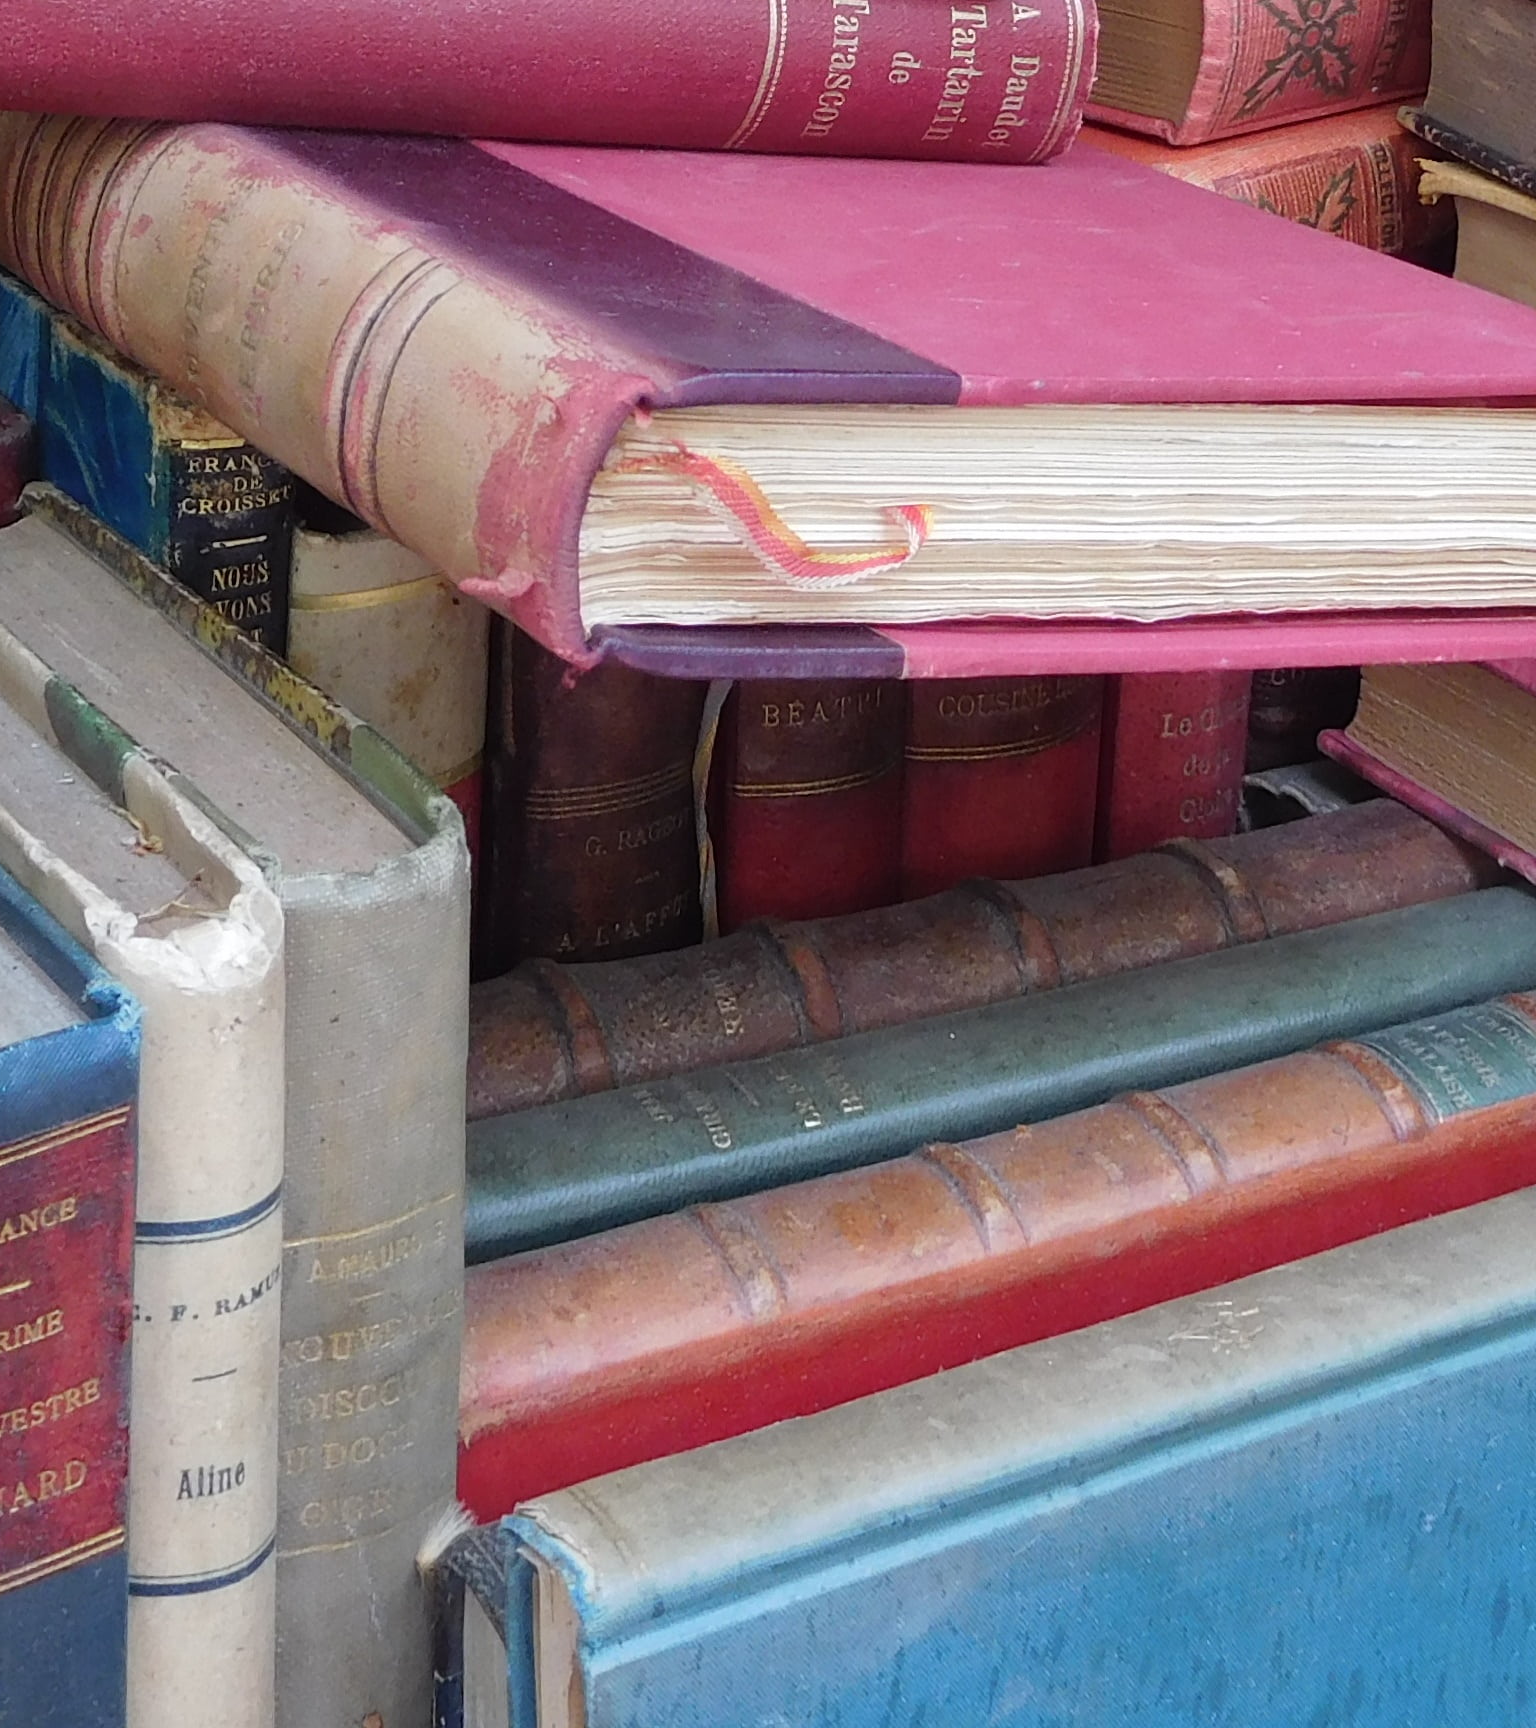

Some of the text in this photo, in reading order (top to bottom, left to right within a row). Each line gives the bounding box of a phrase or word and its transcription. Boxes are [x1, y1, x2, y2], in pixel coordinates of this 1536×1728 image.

[888, 50, 924, 87] de
[922, 3, 990, 144] Tartarin
[993, 0, 1043, 150] A. Daudet
[180, 483, 293, 517] CROISSET
[232, 474, 265, 494] DE
[210, 558, 270, 594] NOUS
[214, 590, 274, 623] VONS
[168, 1301, 202, 1327] F.
[175, 1457, 251, 1506] Aline
